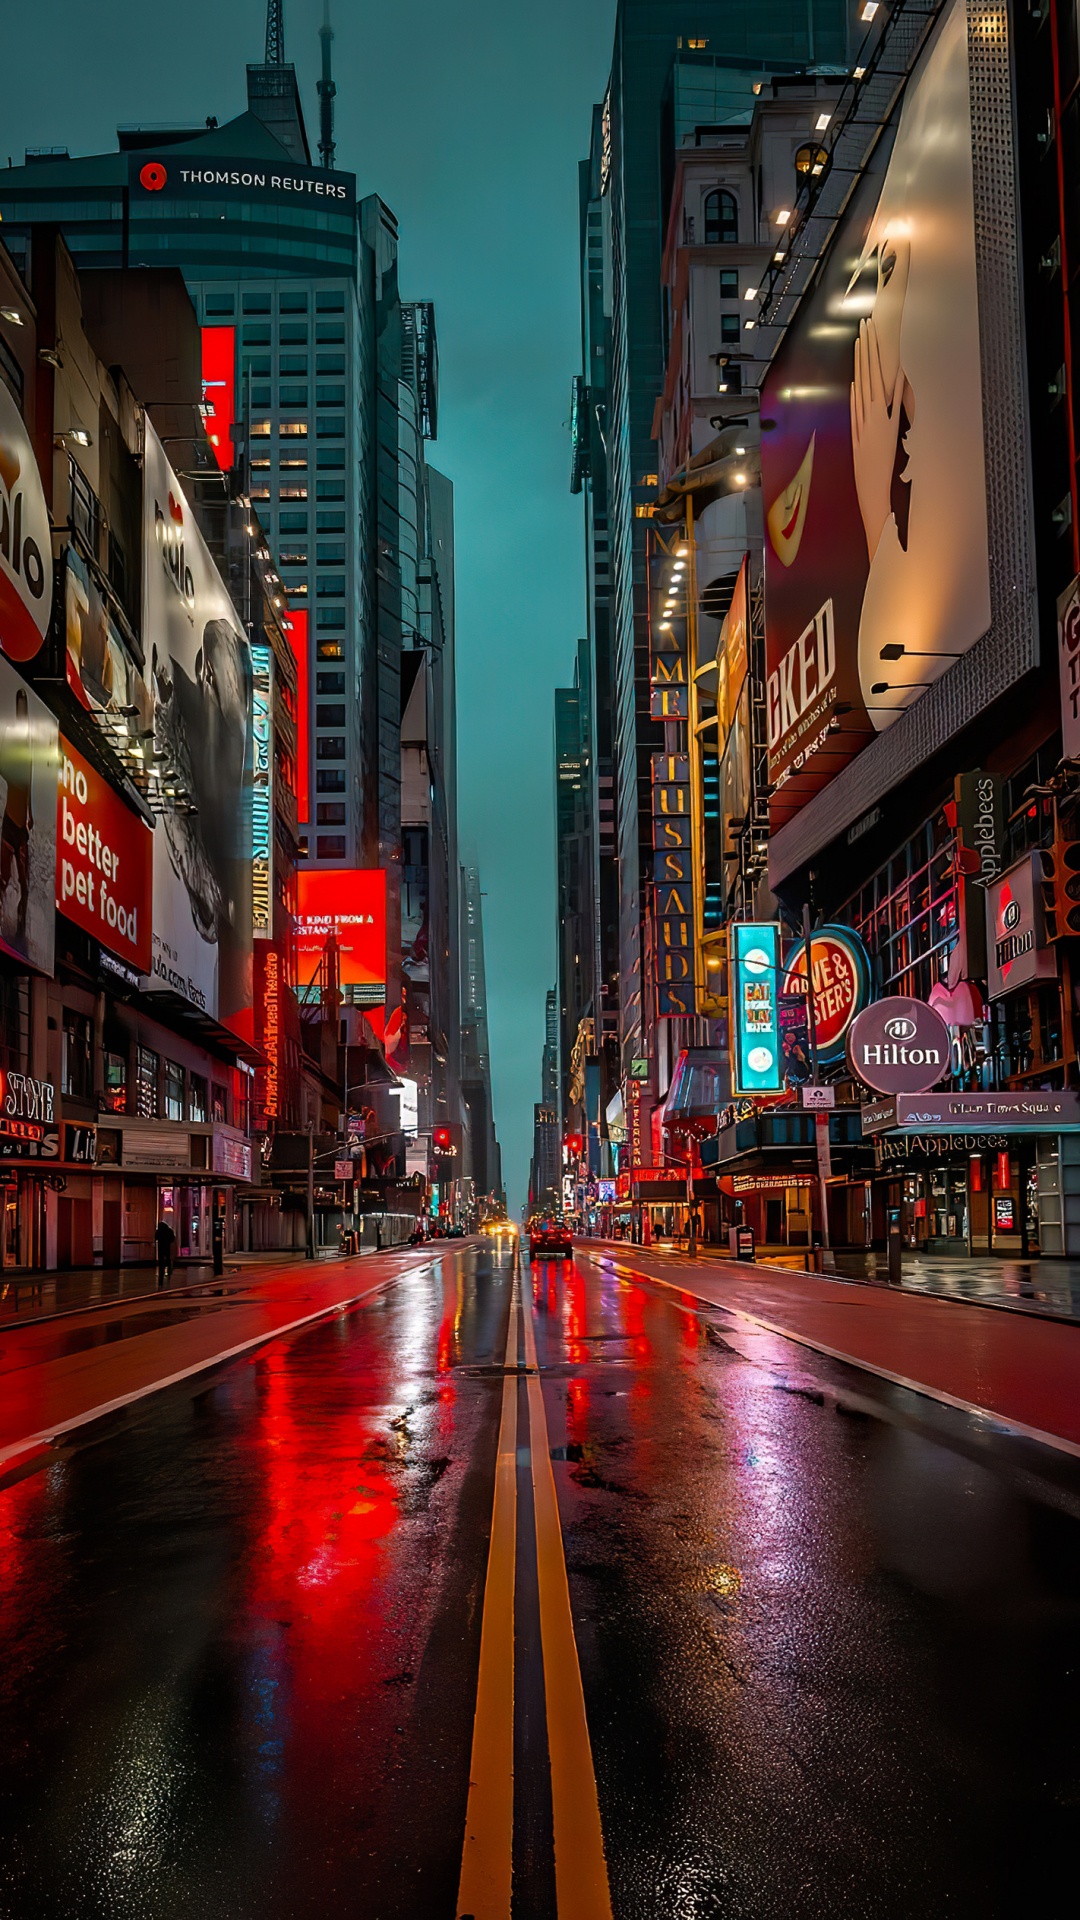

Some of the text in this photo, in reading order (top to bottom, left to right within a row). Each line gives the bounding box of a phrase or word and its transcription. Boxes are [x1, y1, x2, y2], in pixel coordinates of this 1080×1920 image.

[180, 170, 346, 198] THOMSON REUTERS
[63, 755, 88, 806] no
[62, 797, 120, 883] better
[61, 858, 138, 946] pet food
[659, 754, 687, 1014] TUSSAUDS
[863, 1044, 940, 1065] Hilton
